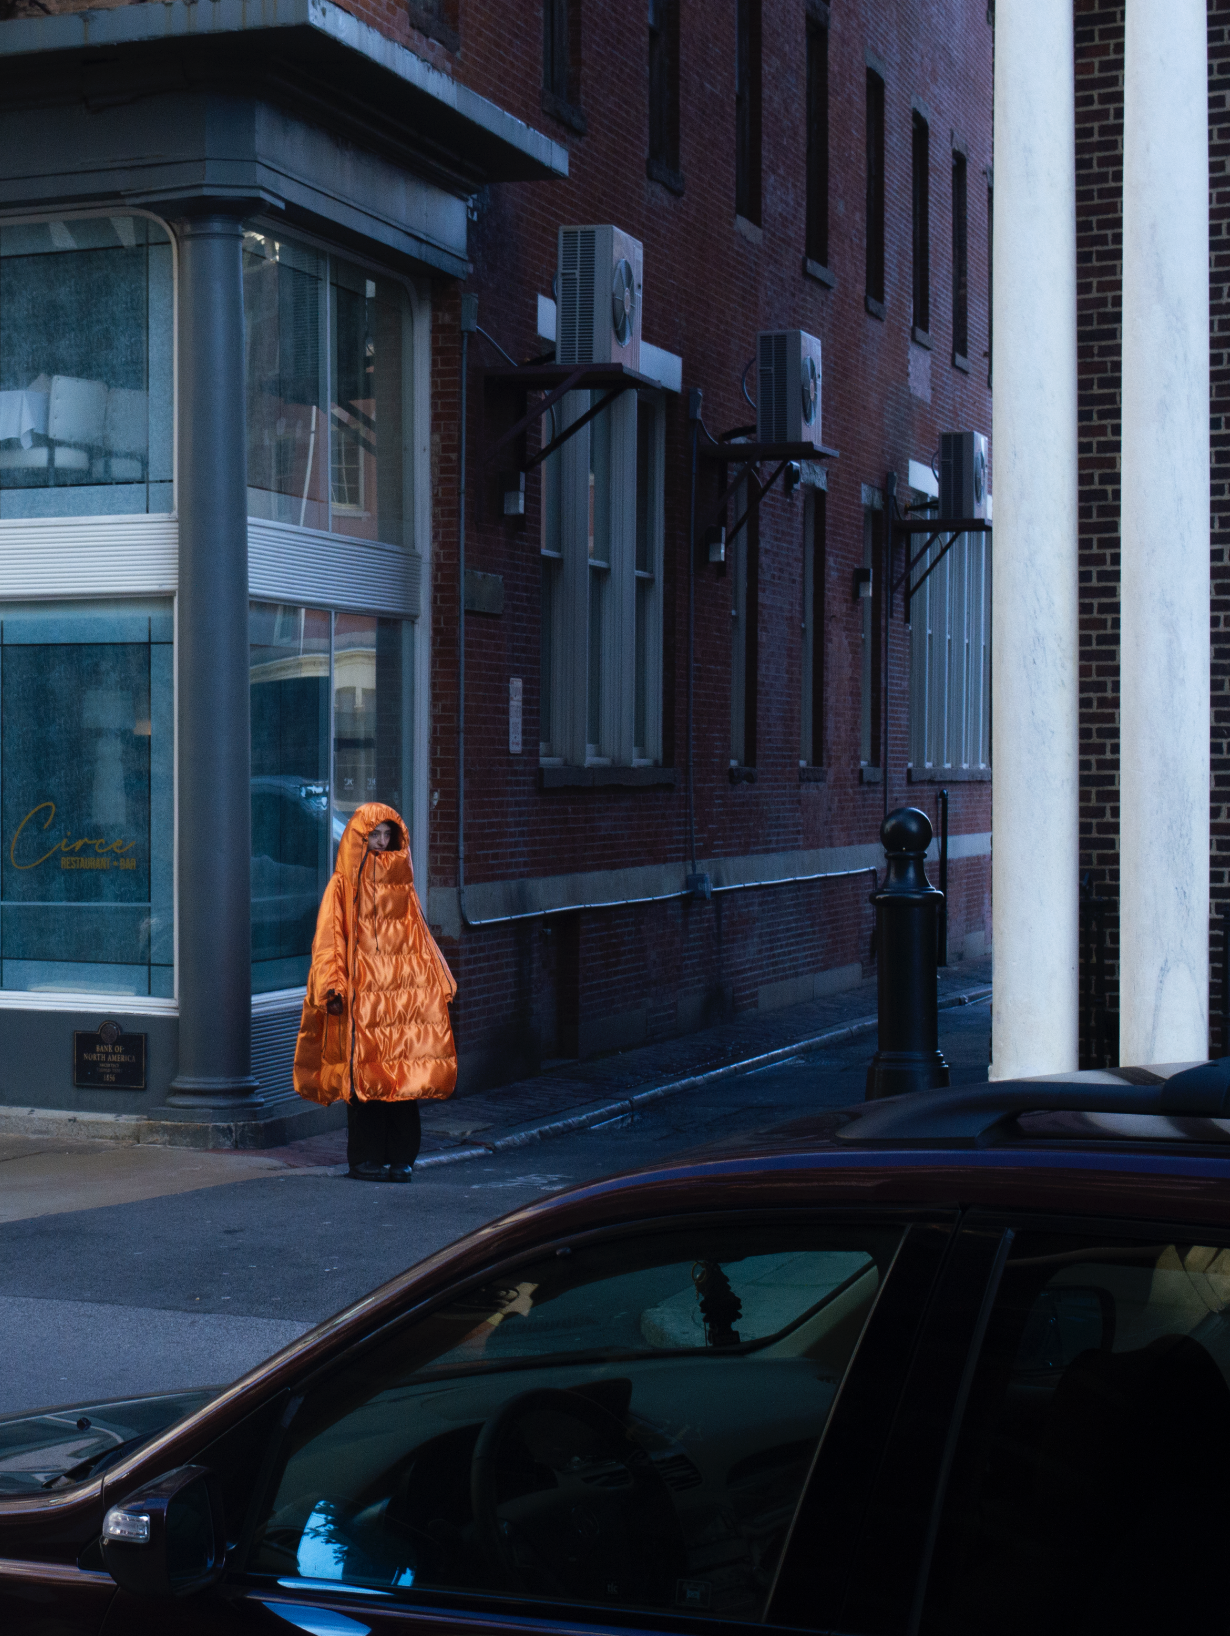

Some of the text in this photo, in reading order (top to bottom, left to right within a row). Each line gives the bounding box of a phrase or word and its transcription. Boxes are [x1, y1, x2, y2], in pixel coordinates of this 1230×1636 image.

[10, 801, 136, 870] Circe
[61, 856, 137, 870] RESTAURANT BAR
[95, 1044, 123, 1053] BANK OF
[83, 1053, 136, 1063] NORTH AMERICA
